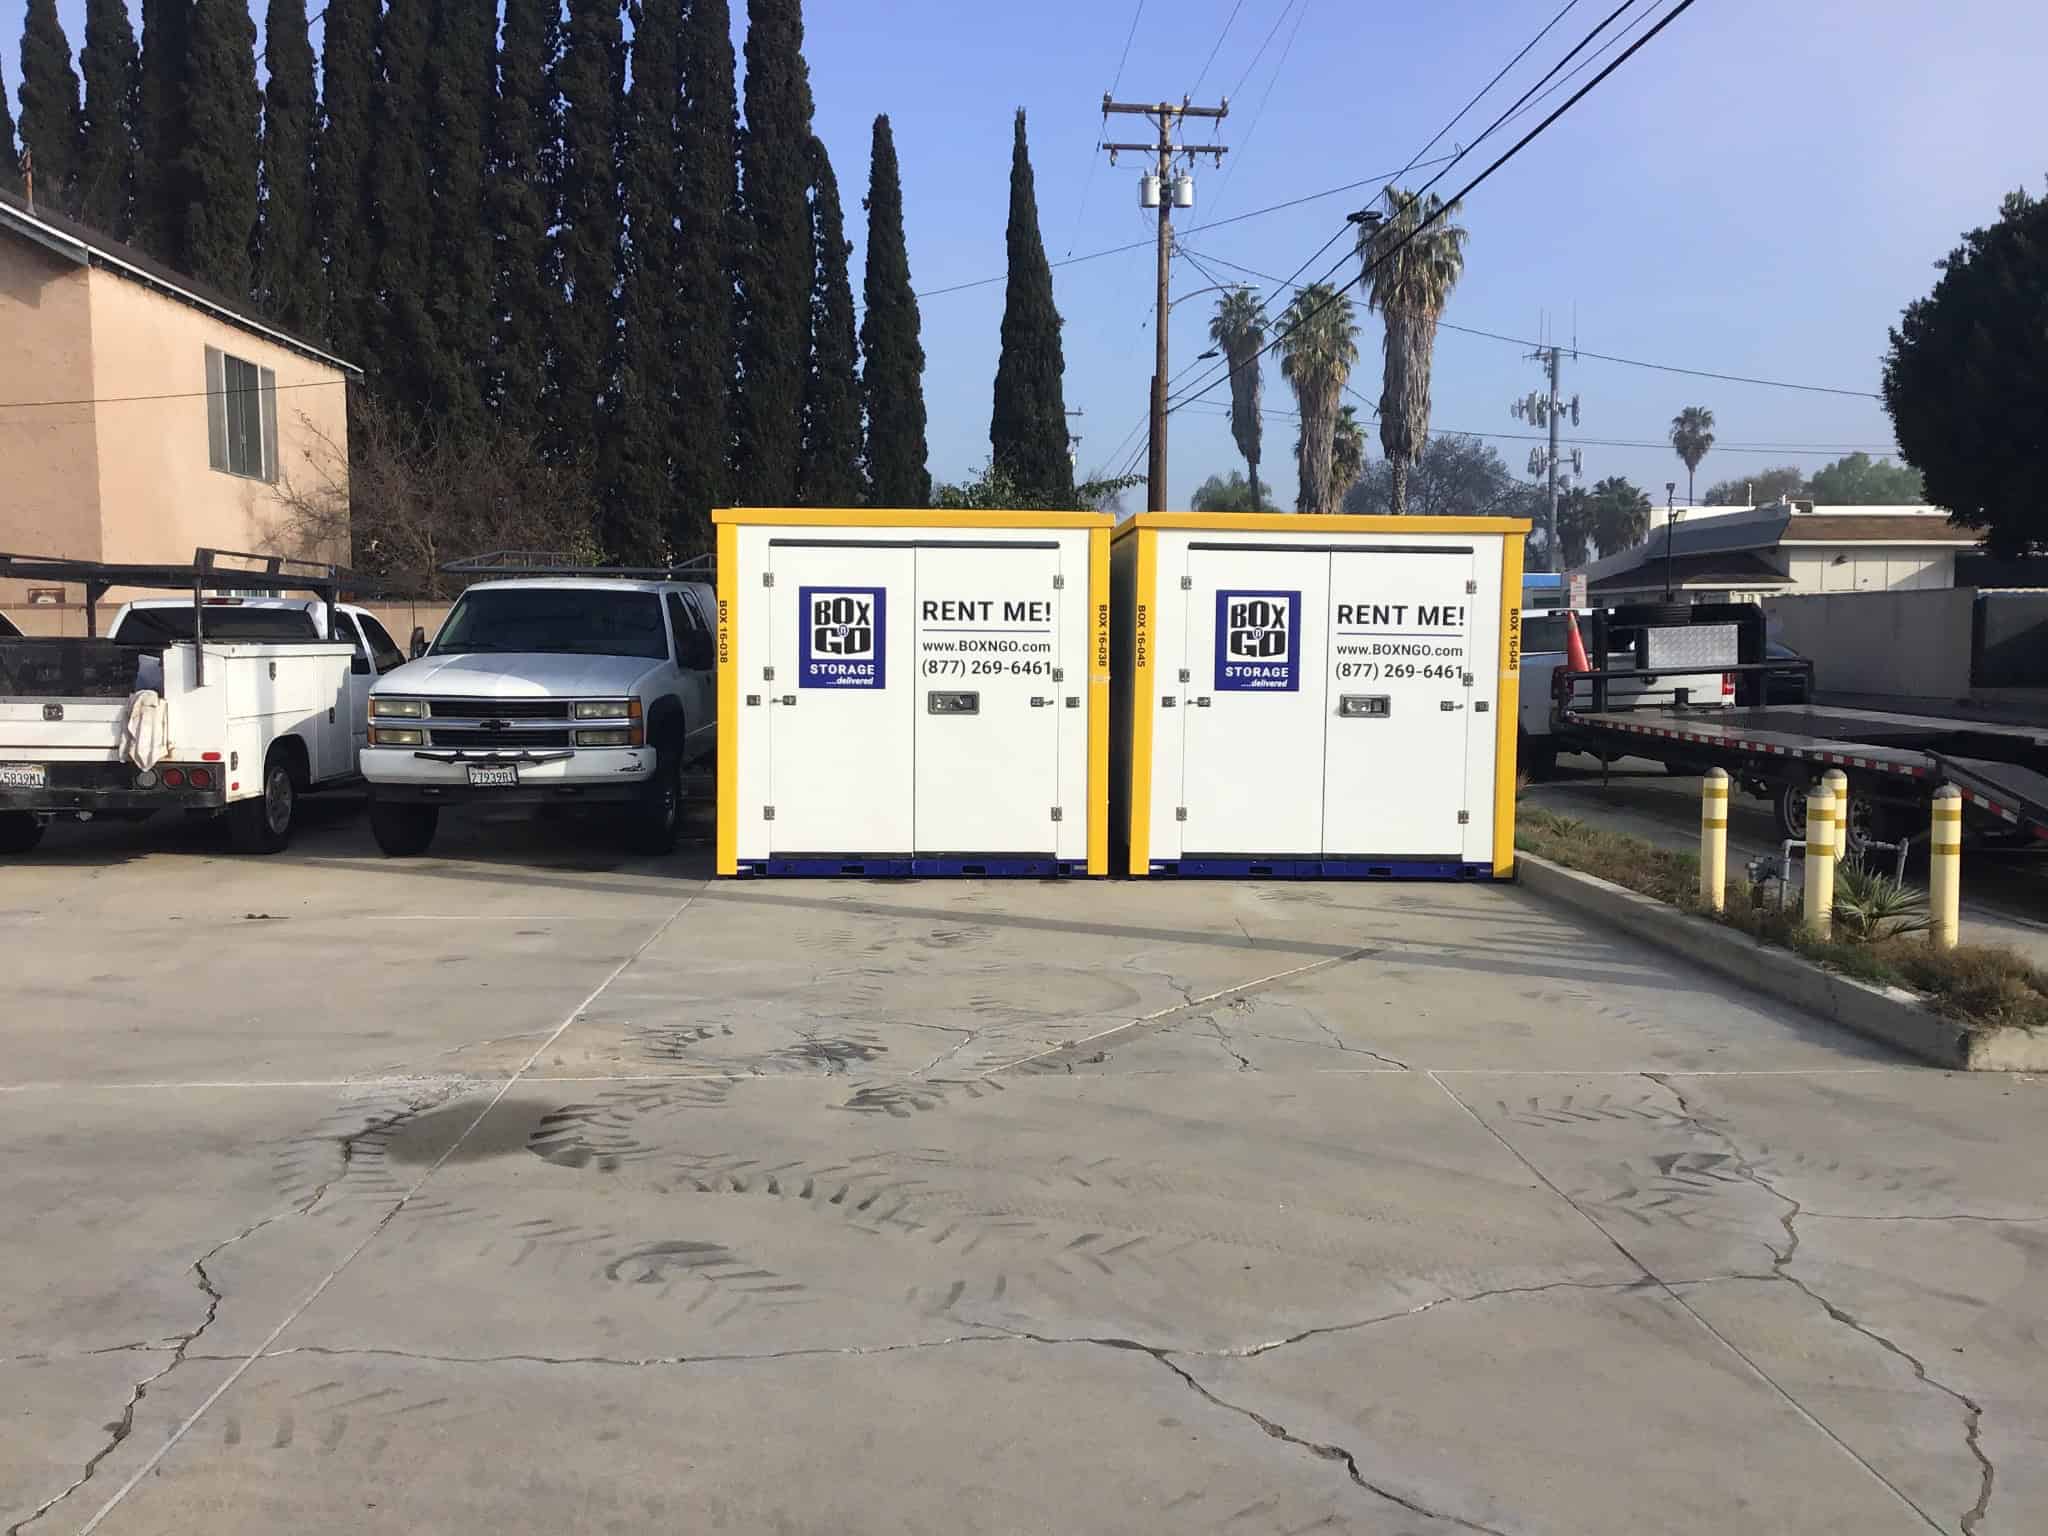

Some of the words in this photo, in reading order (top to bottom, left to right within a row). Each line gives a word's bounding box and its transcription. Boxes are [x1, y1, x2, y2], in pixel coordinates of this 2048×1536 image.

[719, 600, 728, 624] BOX
[814, 597, 870, 626] BOX
[923, 600, 994, 621] RENT
[1004, 601, 1051, 622] ME!
[1098, 604, 1107, 628] BOX
[1137, 604, 1146, 628] BOX
[1231, 600, 1286, 629] BOX
[1337, 604, 1408, 625] RENT
[1418, 605, 1465, 626] ME!
[1510, 608, 1519, 632] BOX
[719, 626, 728, 663] 16-038
[815, 627, 871, 654] GO
[922, 639, 1051, 652] www.BOXNGO.com
[1098, 631, 1107, 667] 16-038
[1137, 631, 1146, 668] 16-045
[1230, 630, 1286, 657] GO
[1336, 643, 1463, 656] www.BOXNGO.com
[1509, 635, 1518, 671] 16-045
[810, 664, 875, 675] STORAGE
[922, 658, 966, 678] (877)
[971, 660, 1051, 675] 269-6461
[1225, 666, 1289, 677] STORAGE
[1335, 661, 1379, 680] (877)
[1384, 663, 1463, 679] 269-6461
